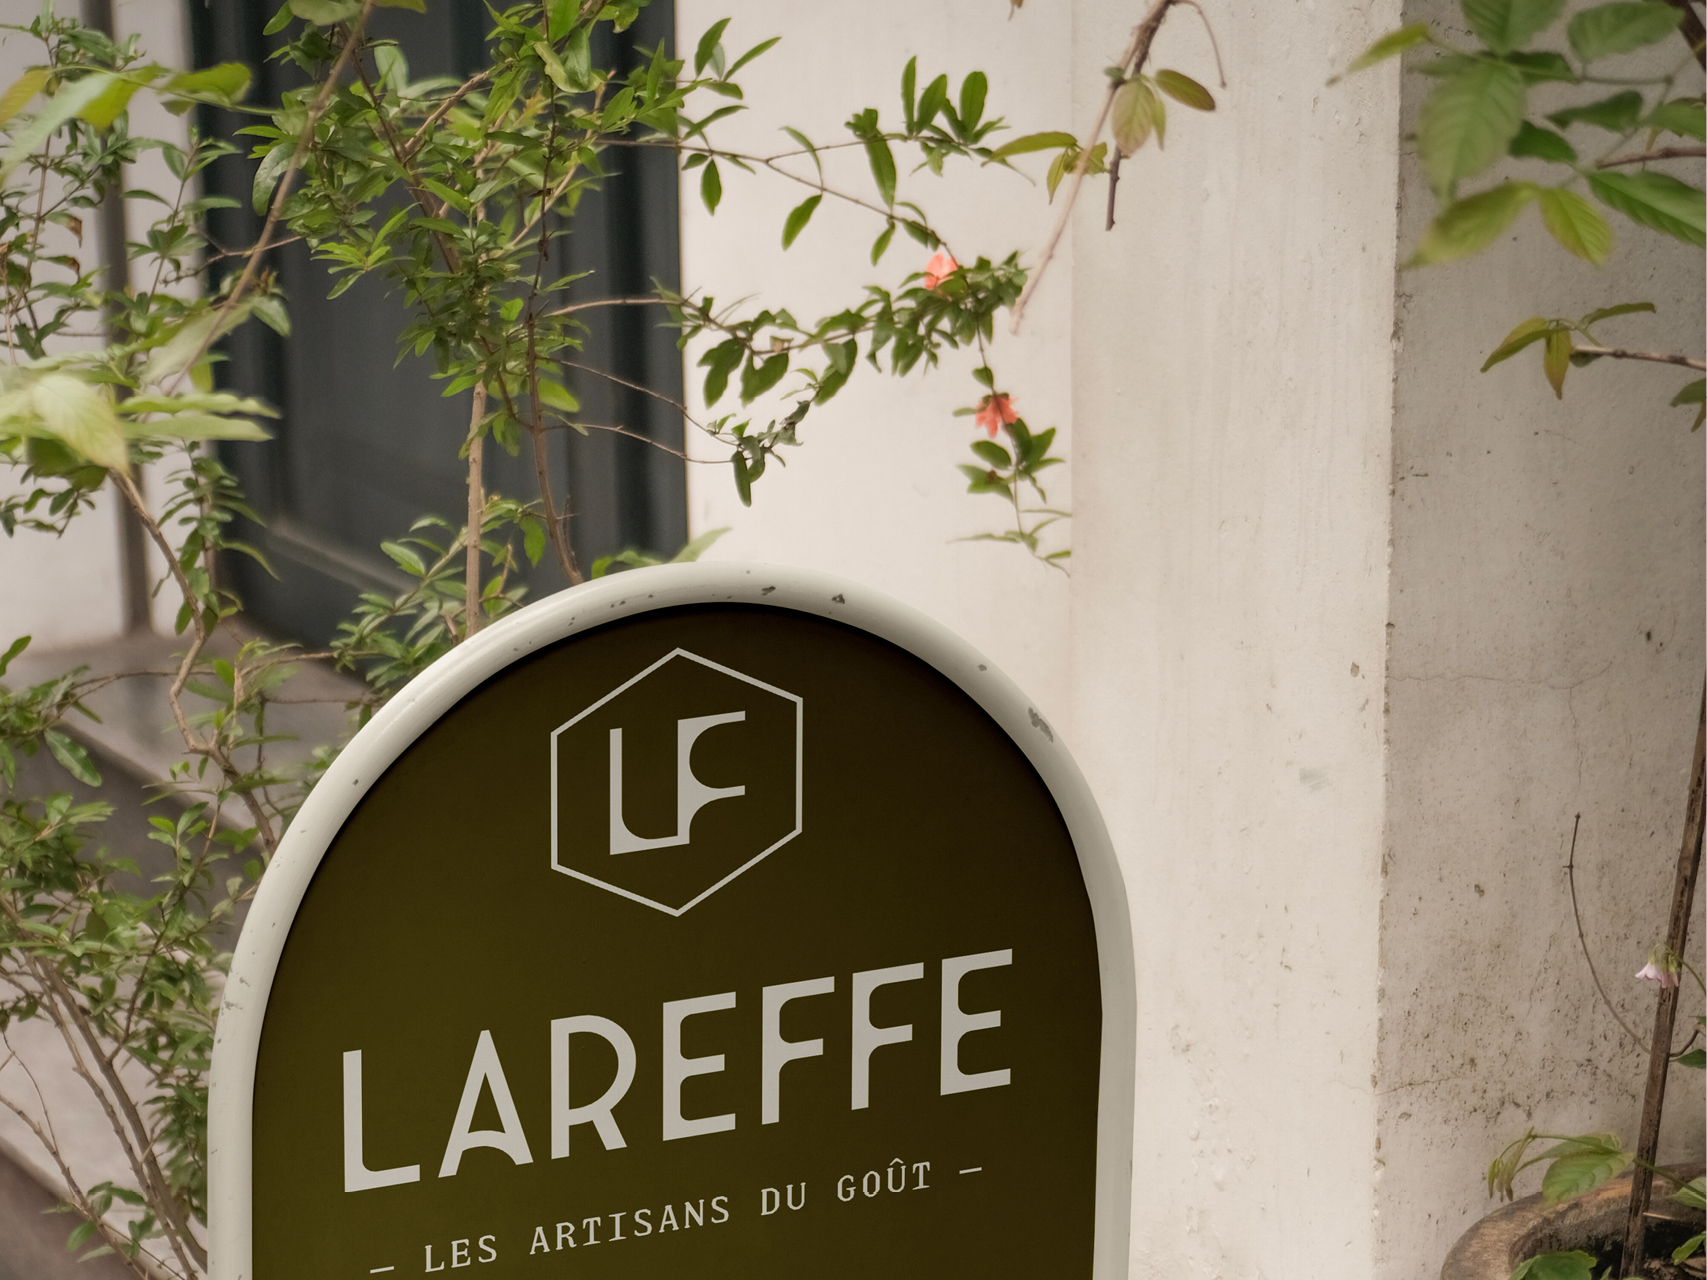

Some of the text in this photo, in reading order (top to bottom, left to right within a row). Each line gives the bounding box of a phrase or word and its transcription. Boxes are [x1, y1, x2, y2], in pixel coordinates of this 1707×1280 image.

[343, 949, 1012, 1192] LAREFFE
[425, 1235, 497, 1273] LES
[530, 1192, 730, 1255] ARTISANS
[761, 1182, 806, 1216] DU
[837, 1157, 932, 1202] GOÛT
